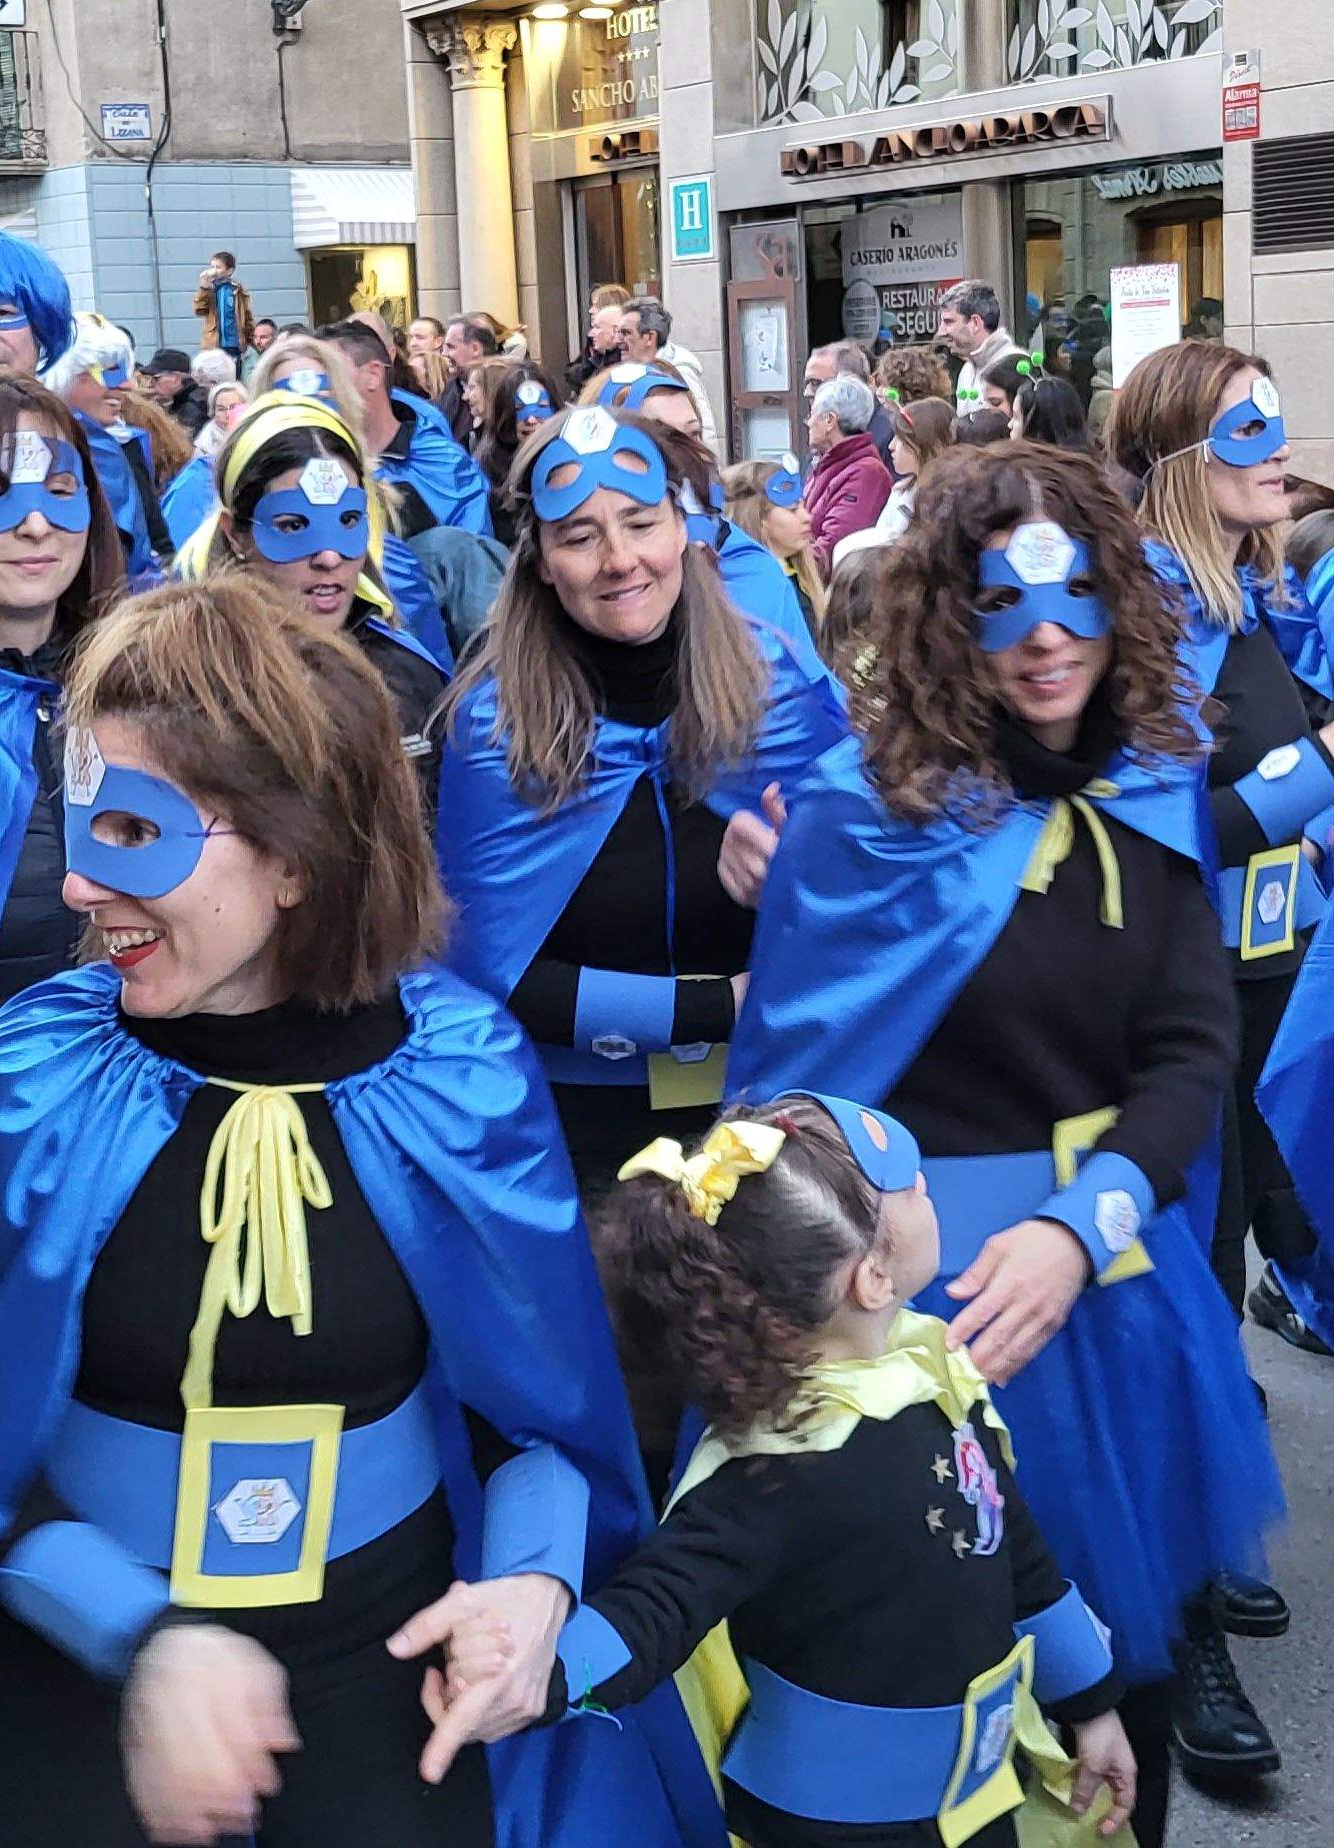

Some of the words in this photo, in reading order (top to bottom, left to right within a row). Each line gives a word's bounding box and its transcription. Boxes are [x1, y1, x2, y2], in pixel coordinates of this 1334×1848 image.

[606, 5, 658, 40] HOTEL
[572, 80, 635, 112] SANCHO
[1224, 87, 1257, 102] Alarma
[679, 189, 704, 231] H
[850, 245, 894, 266] CASERÍO
[898, 238, 958, 262] ARAGONÉS
